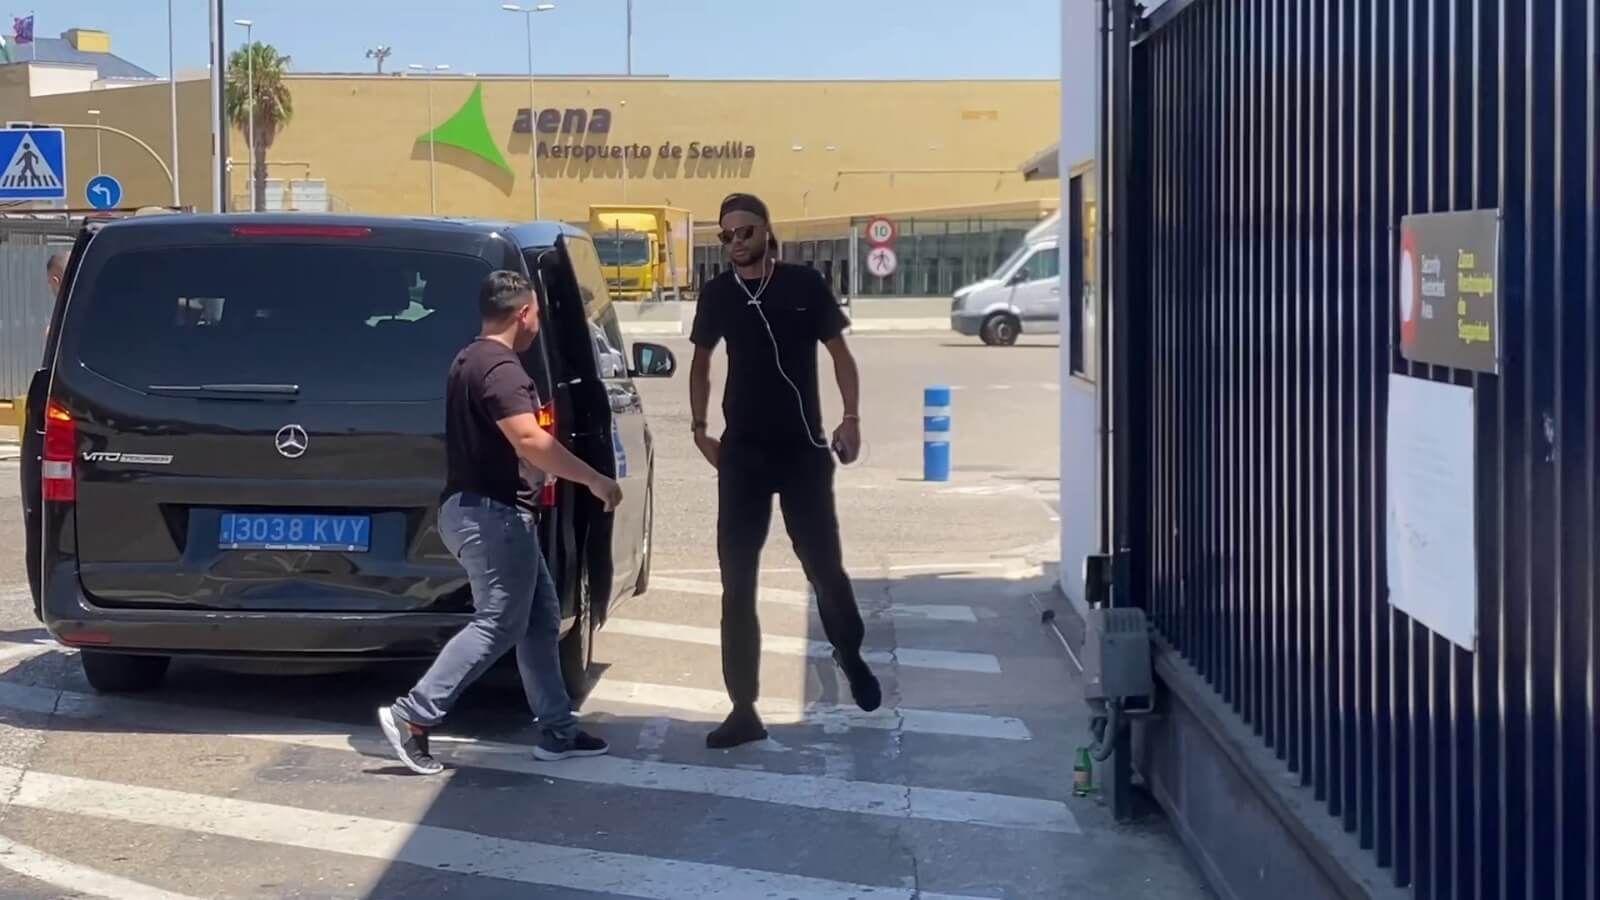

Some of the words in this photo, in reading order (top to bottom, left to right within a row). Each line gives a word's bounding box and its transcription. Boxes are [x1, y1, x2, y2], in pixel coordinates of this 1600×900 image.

[512, 107, 613, 134] aena
[536, 141, 652, 163] Aeropuerto
[658, 141, 682, 160] de
[687, 141, 756, 160] Sevilla
[874, 225, 888, 238] 10
[82, 451, 121, 462] VITO
[236, 517, 303, 541] 3038
[313, 519, 365, 543] KVY
